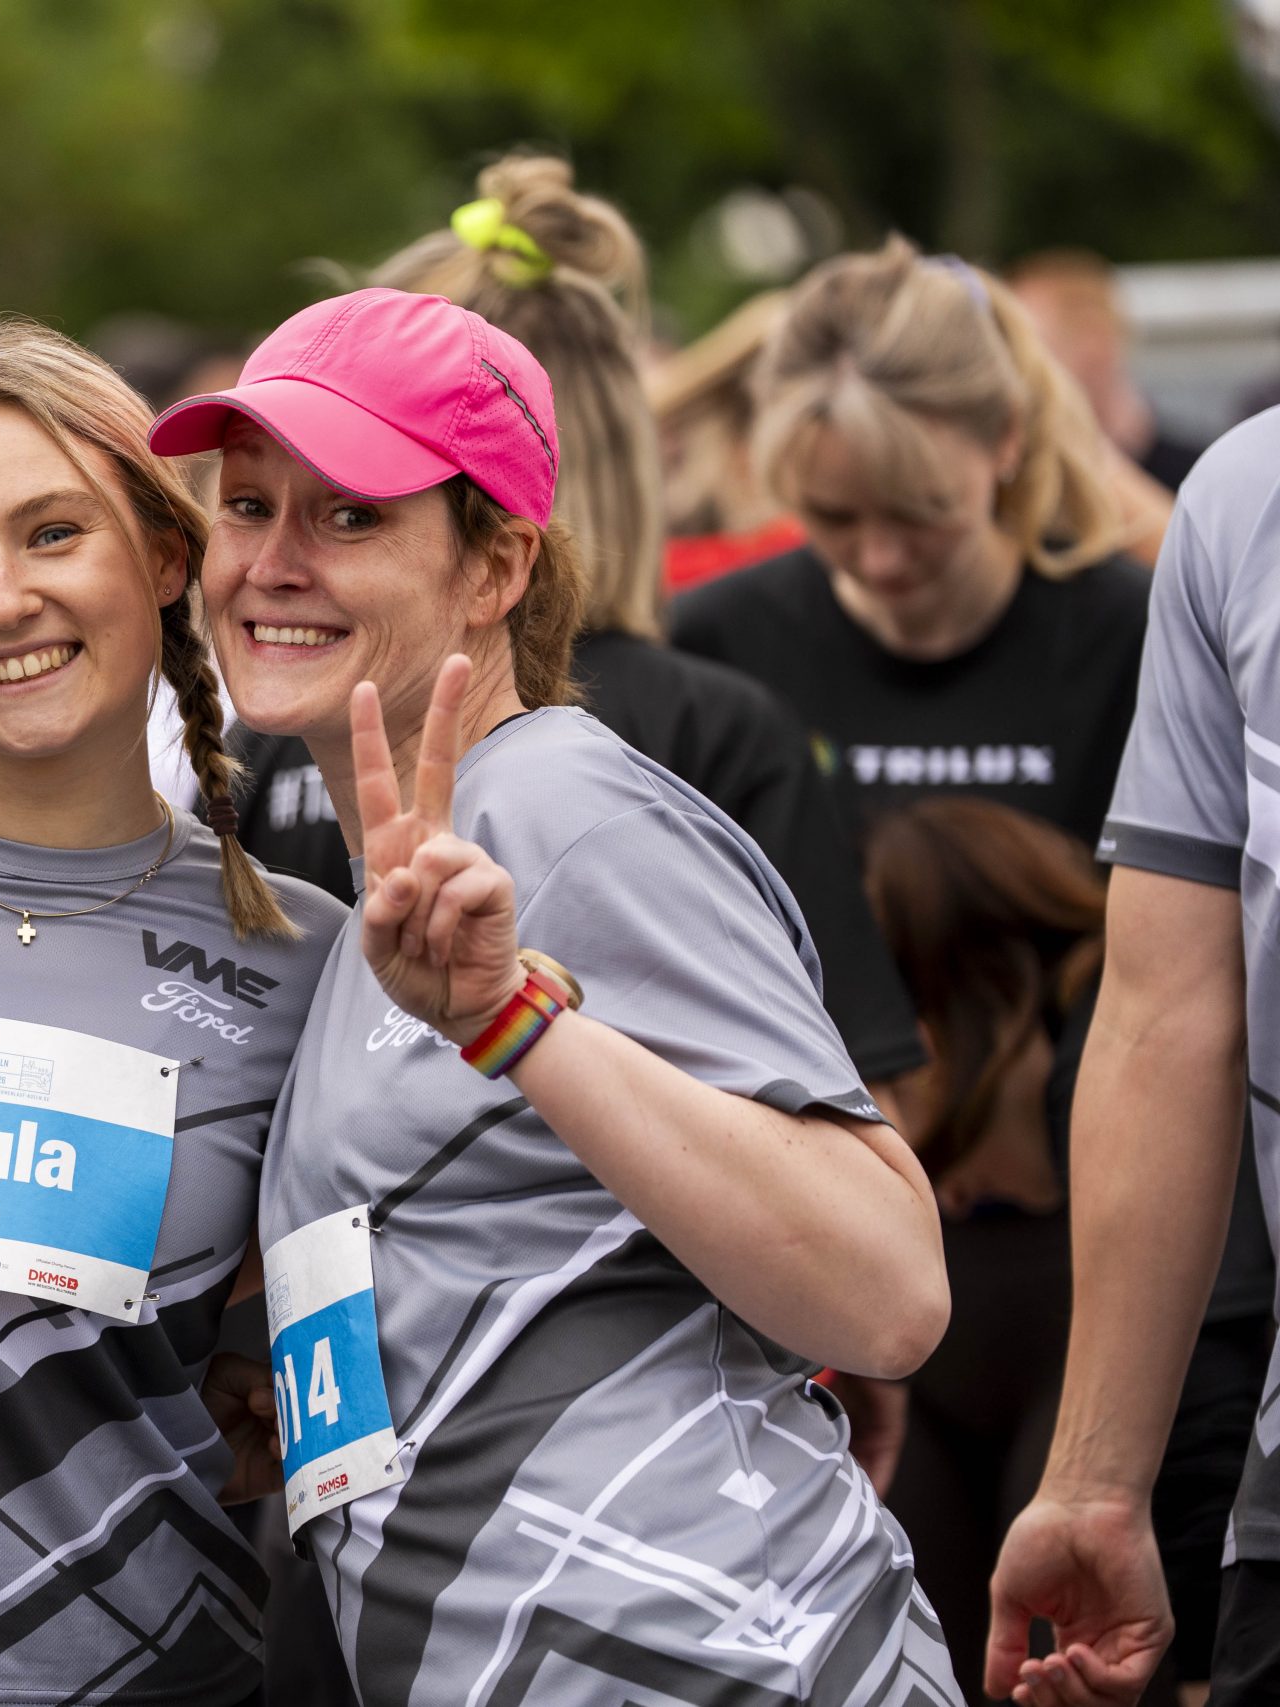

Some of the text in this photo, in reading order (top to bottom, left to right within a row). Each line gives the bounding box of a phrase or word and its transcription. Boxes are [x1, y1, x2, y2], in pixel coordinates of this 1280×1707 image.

[849, 744, 1055, 786] TRILUX
[142, 929, 281, 1009] VME
[141, 981, 254, 1045] Ford
[28, 1268, 68, 1288] DKMS
[317, 1476, 341, 1497] DKMS
